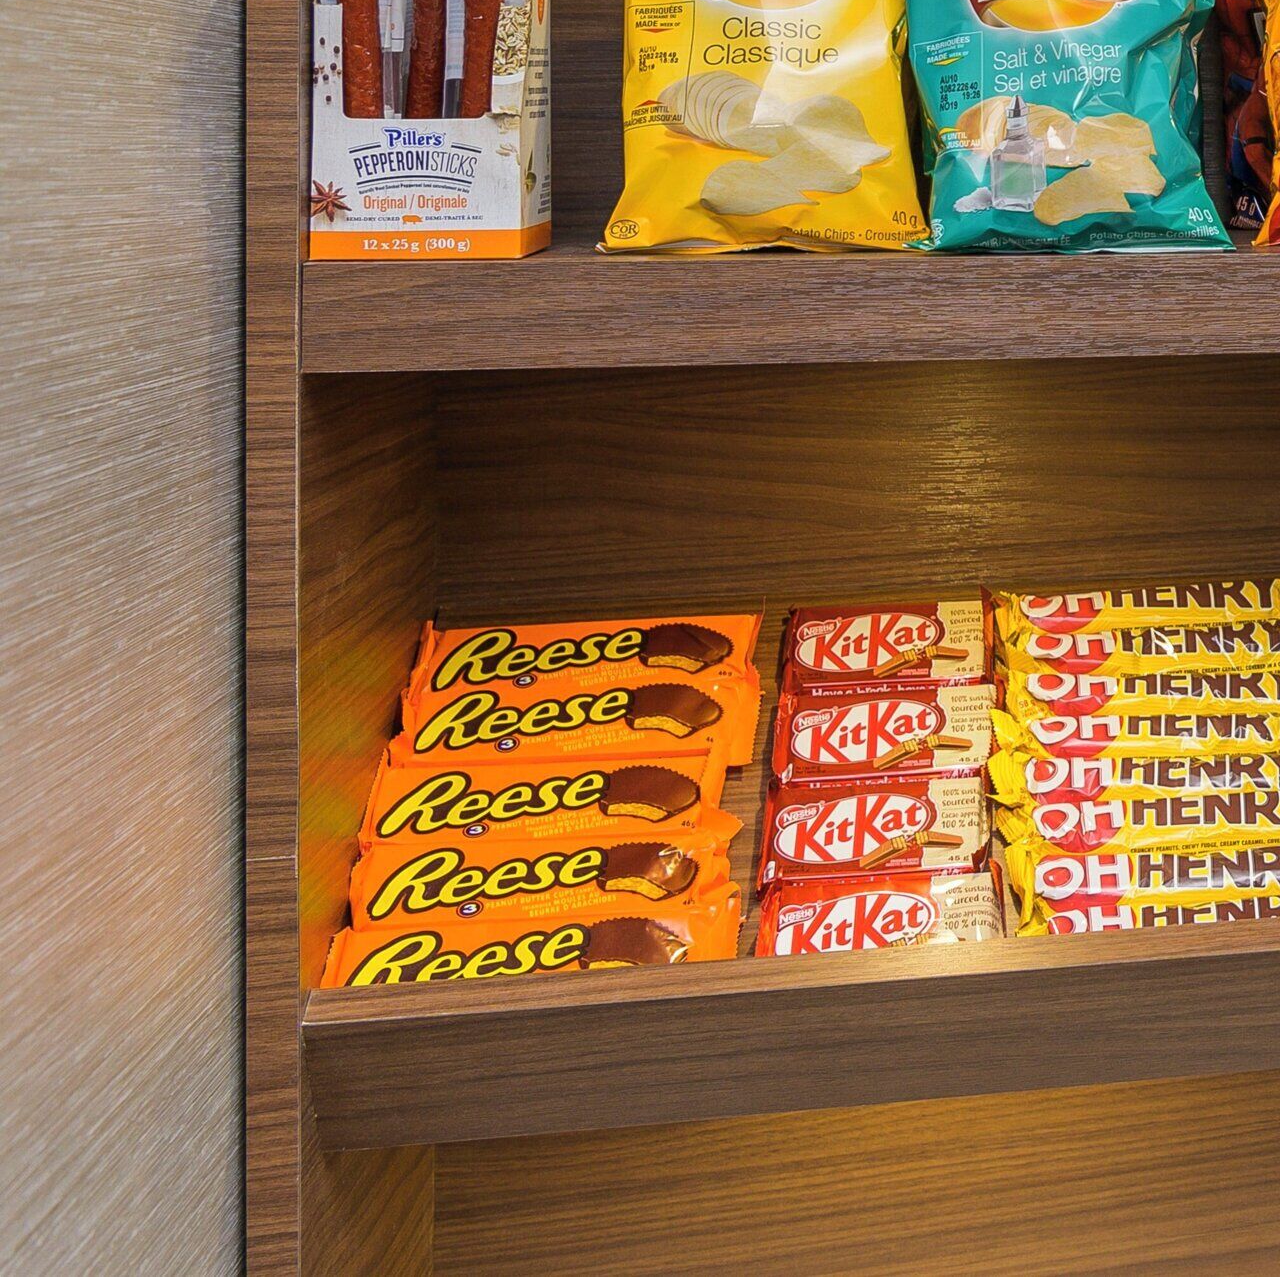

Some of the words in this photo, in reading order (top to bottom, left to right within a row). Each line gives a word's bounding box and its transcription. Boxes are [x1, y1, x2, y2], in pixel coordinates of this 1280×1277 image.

[635, 6, 683, 16] FABRIQUÉES
[635, 20, 658, 29] MADE
[722, 17, 822, 41] Classic
[703, 43, 839, 68] Classique
[993, 49, 1028, 70] Salt
[1034, 43, 1047, 64] &
[1050, 40, 1121, 64] Vinegar
[993, 71, 1025, 93] Sel
[1029, 72, 1047, 89] et
[1052, 64, 1122, 87] vinaigre
[383, 128, 443, 148] Piller's
[363, 195, 407, 212] Original
[417, 194, 468, 212] Originale
[1188, 207, 1204, 222] 40
[1205, 210, 1213, 224] g
[363, 239, 378, 250] 12
[381, 242, 390, 250] x
[391, 239, 409, 250] 25
[411, 242, 420, 252] g
[425, 238, 455, 251] (300
[457, 238, 470, 252] g)
[434, 629, 644, 692] Reese
[1027, 673, 1118, 700] OH
[376, 771, 606, 838] Reese
[1032, 799, 1126, 838] OH
[1131, 846, 1154, 854] CRUNCHY
[369, 848, 603, 920] Reese
[1034, 853, 1133, 899] OH
